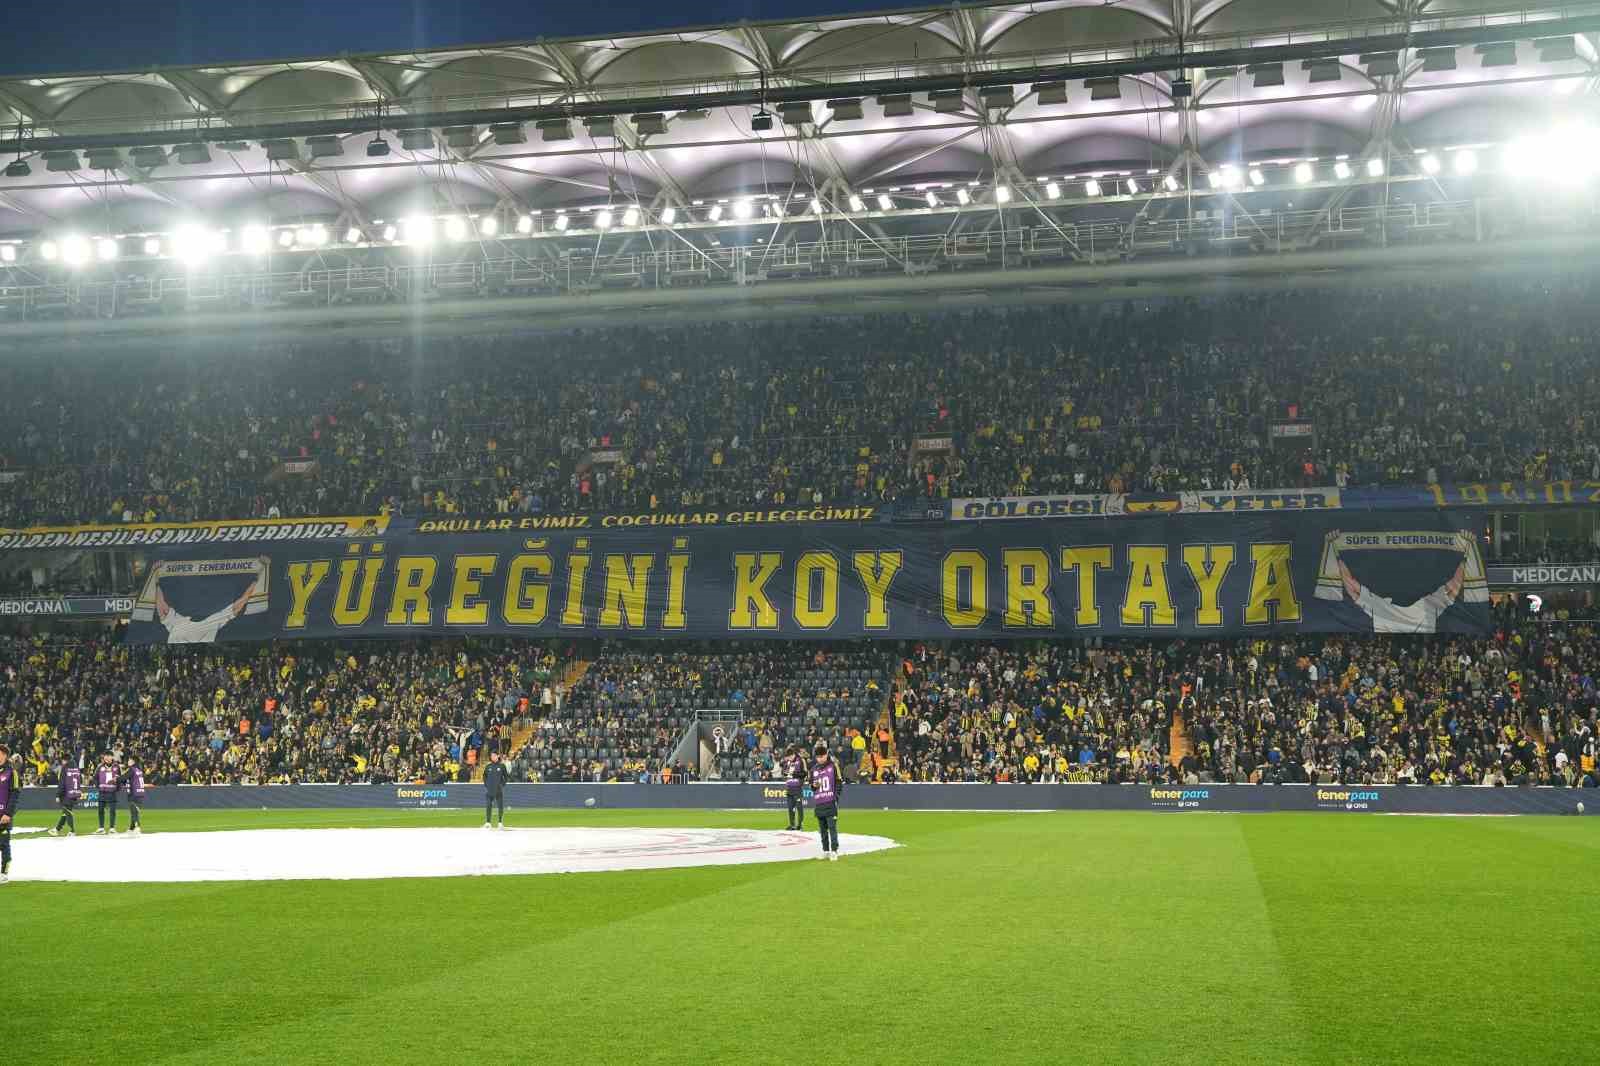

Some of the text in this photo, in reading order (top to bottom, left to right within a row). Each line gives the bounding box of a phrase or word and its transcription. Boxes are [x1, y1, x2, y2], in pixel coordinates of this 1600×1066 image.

[1200, 492, 1328, 510] YETER
[418, 519, 513, 532] OKULLAR
[1345, 534, 1380, 545] SÜPER
[283, 536, 1302, 631] YÜREĞİNİ KOY ORTAYA
[104, 599, 136, 612] MEDI
[397, 788, 447, 799] fenerpara
[1150, 788, 1209, 800] fenerpara
[1316, 789, 1379, 802] fenerpara
